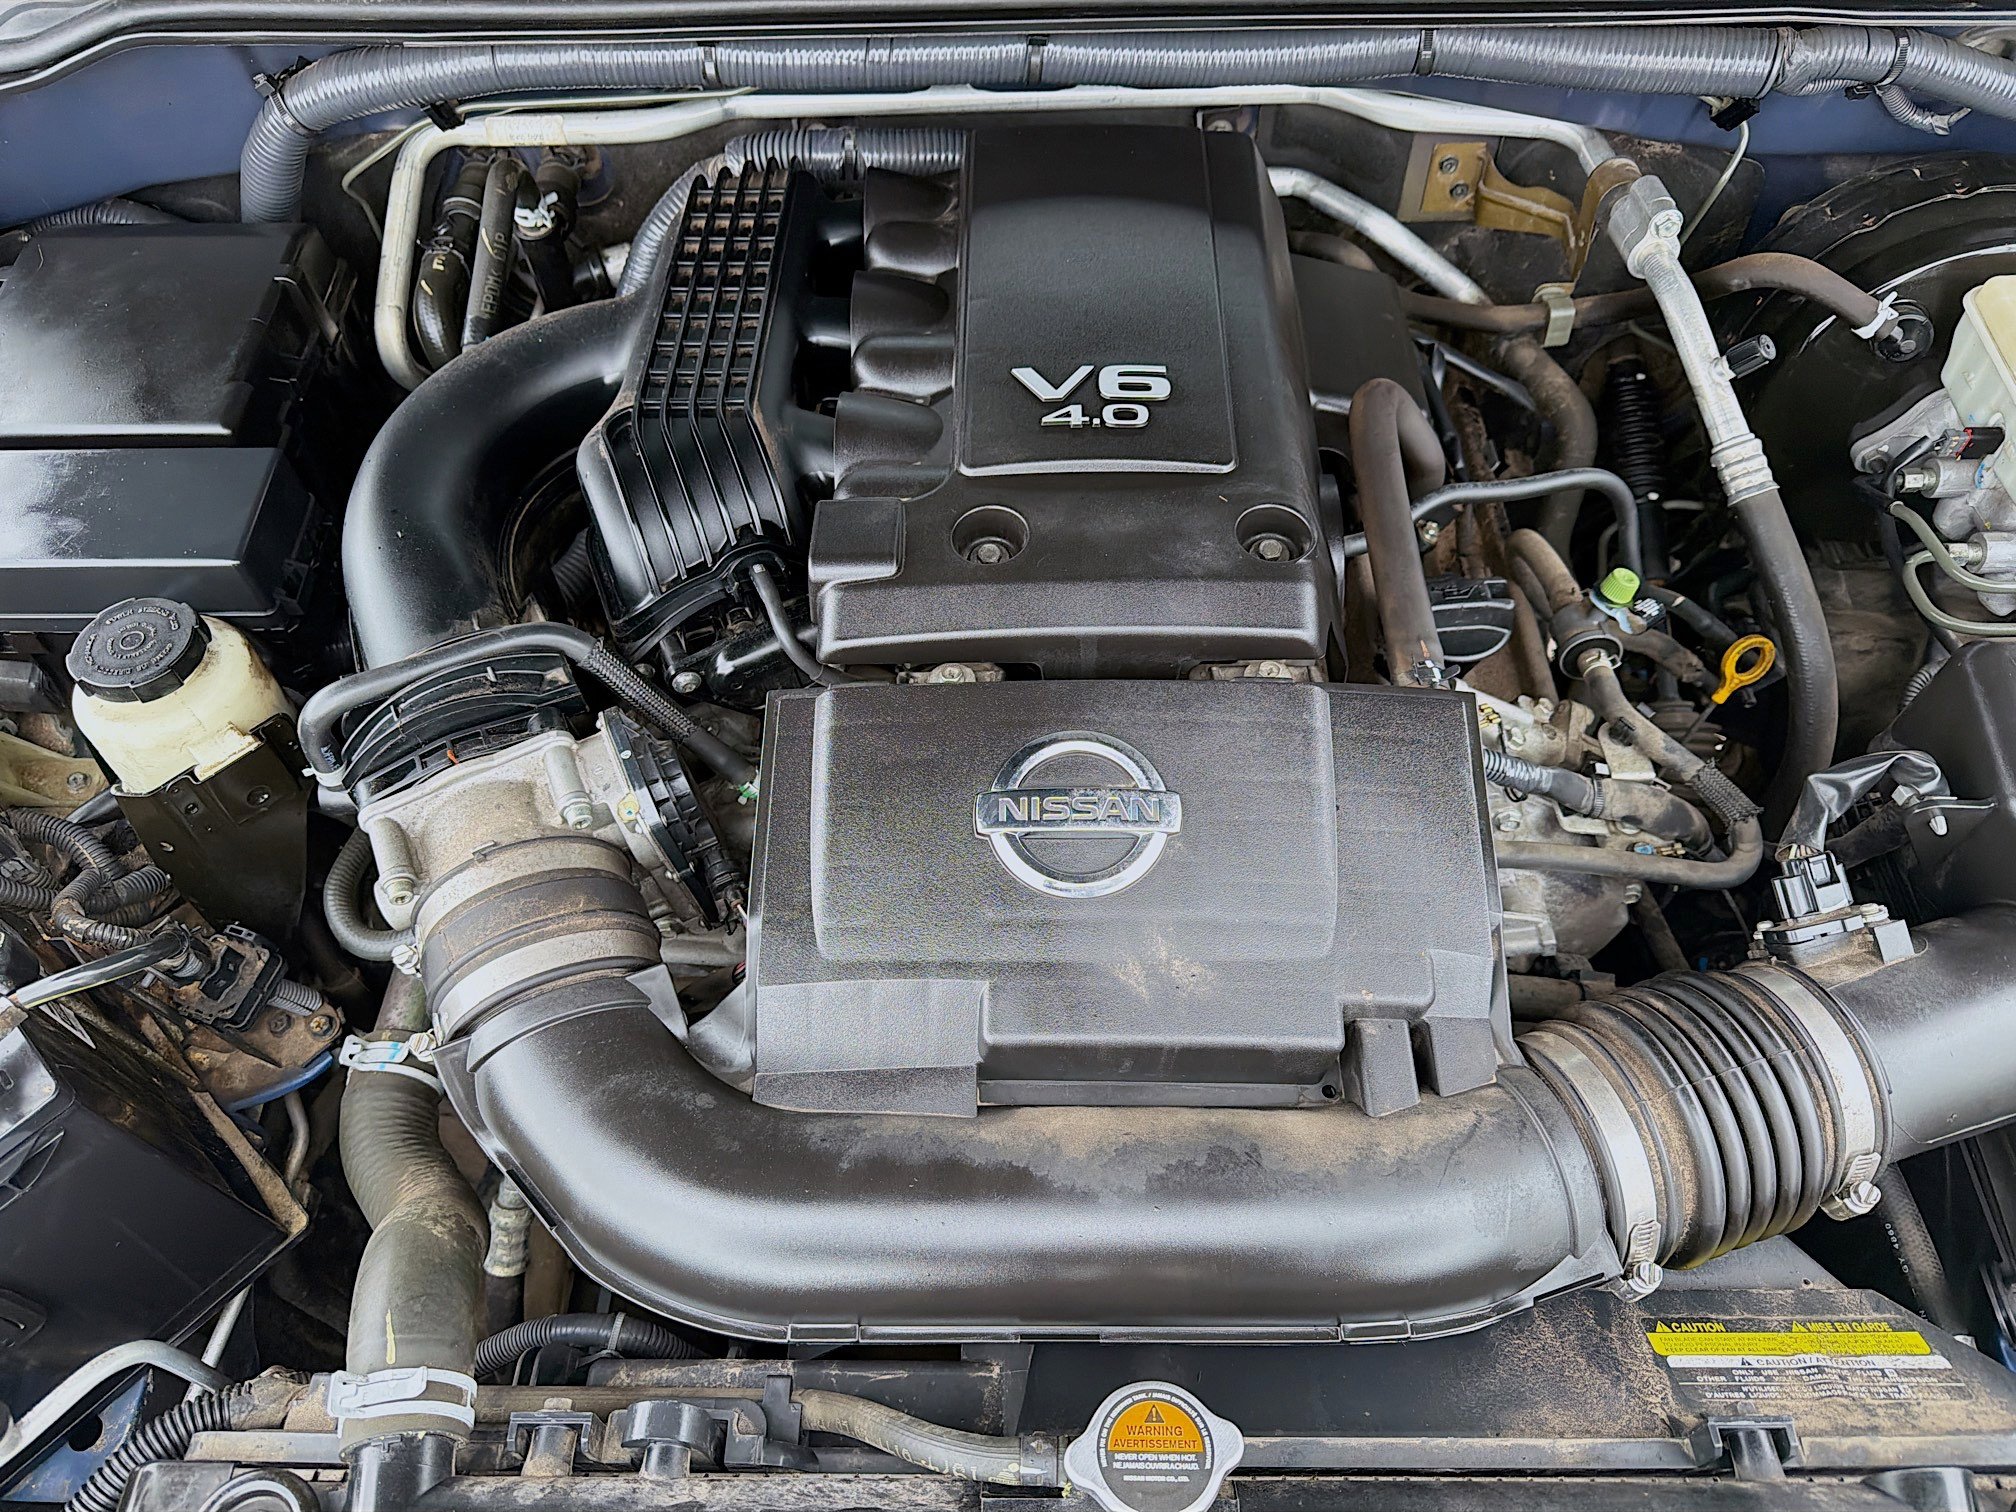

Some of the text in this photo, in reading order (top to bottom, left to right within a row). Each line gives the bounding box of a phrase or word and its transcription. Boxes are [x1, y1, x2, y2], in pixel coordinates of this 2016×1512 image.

[1011, 365, 1171, 402] V6
[1041, 403, 1149, 428] 4.0
[998, 797, 1160, 821] NISSAN
[1671, 1322, 1726, 1333] CAUTION
[1806, 1322, 1893, 1332] MISE EN GARDE
[1756, 1358, 1807, 1367] CAUTION
[1815, 1357, 1876, 1367] ATTENTION
[1705, 1391, 1746, 1399] D'AUTRES
[1127, 1425, 1183, 1436] WARNING
[1113, 1439, 1198, 1449] AVERTISSEMENT
[1115, 1453, 1198, 1461] NEVER OPEN WHEN HOT.
